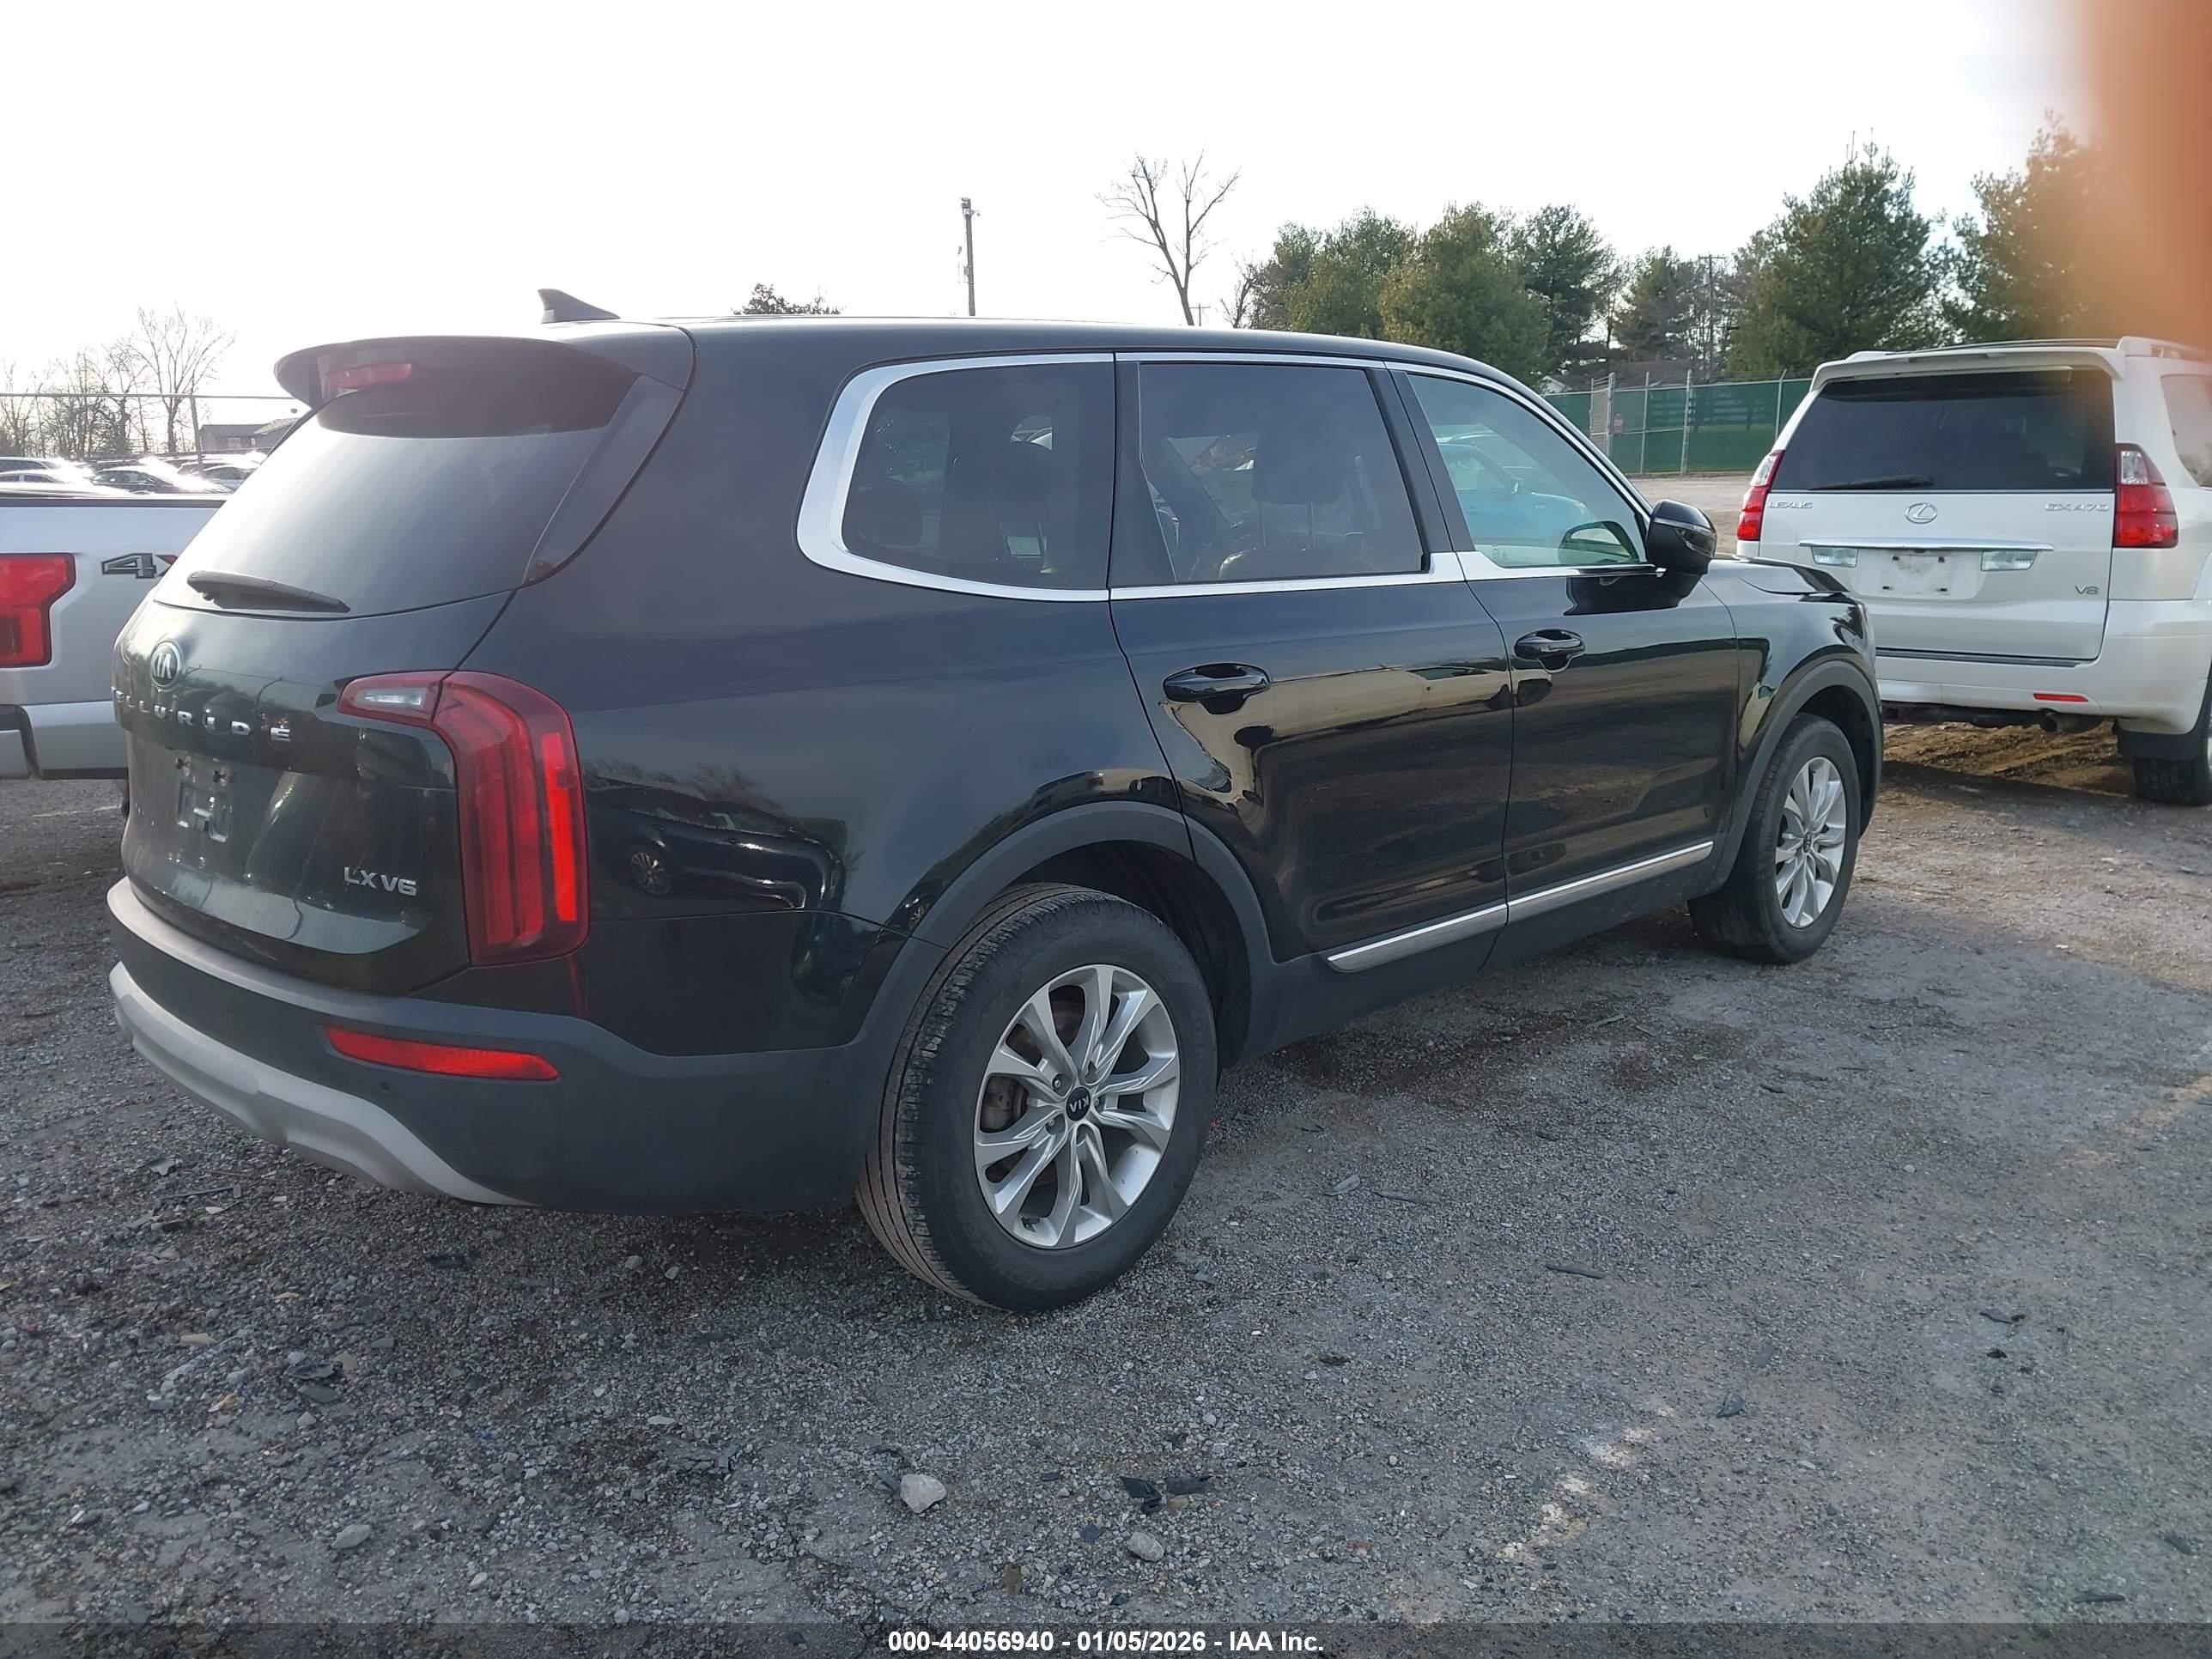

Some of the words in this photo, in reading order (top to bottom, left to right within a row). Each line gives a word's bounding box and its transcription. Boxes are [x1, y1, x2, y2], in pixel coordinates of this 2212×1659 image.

[1768, 501, 1814, 510] LEXUS
[2073, 502, 2109, 513] 470
[2075, 585, 2100, 595] V8
[344, 866, 377, 889] LX
[380, 874, 417, 896] V6
[1069, 1095, 1090, 1113] KIA
